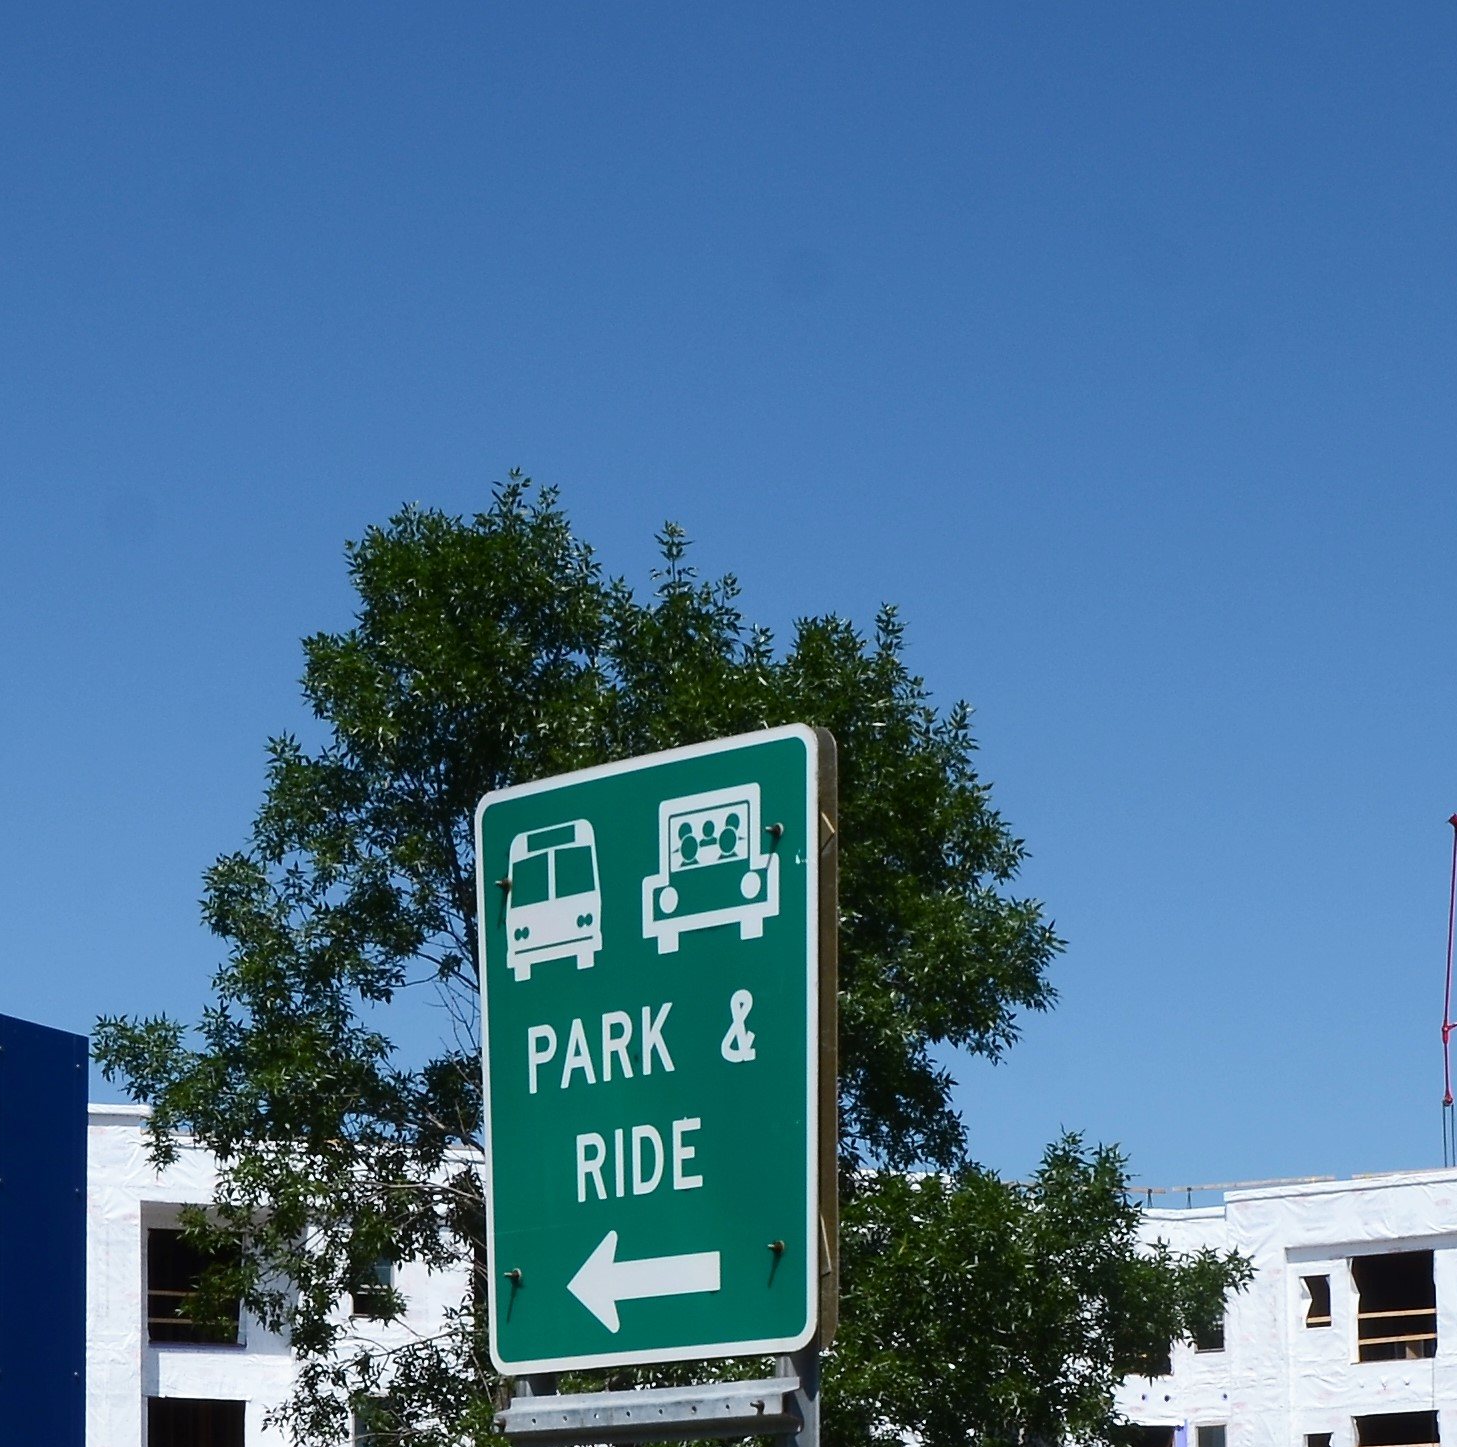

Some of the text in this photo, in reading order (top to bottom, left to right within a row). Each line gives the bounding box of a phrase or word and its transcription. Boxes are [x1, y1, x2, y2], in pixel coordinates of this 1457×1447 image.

[528, 989, 756, 1094] PARK &
[576, 1117, 703, 1202] RIDE
